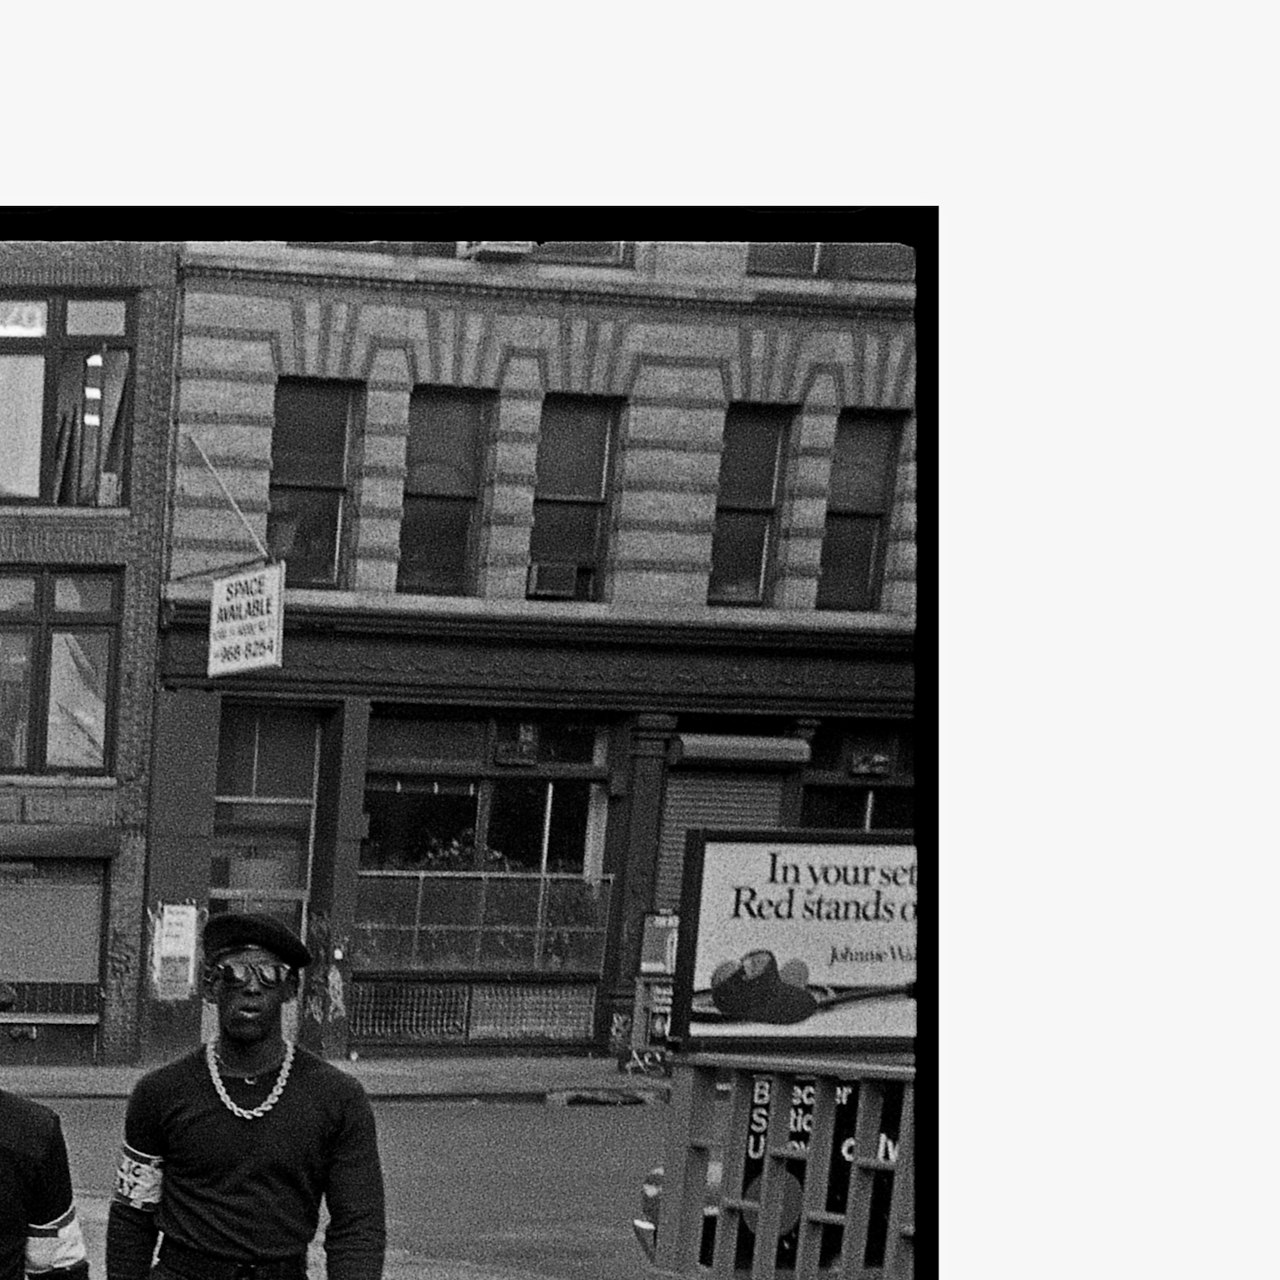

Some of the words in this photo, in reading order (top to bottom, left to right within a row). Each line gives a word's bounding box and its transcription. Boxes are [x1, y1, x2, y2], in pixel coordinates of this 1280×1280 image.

[225, 575, 265, 602] SPACE
[216, 597, 272, 623] AVAILABLE
[769, 852, 801, 885] In
[806, 864, 876, 894] your
[732, 886, 795, 920] Red
[801, 889, 895, 922] stands
